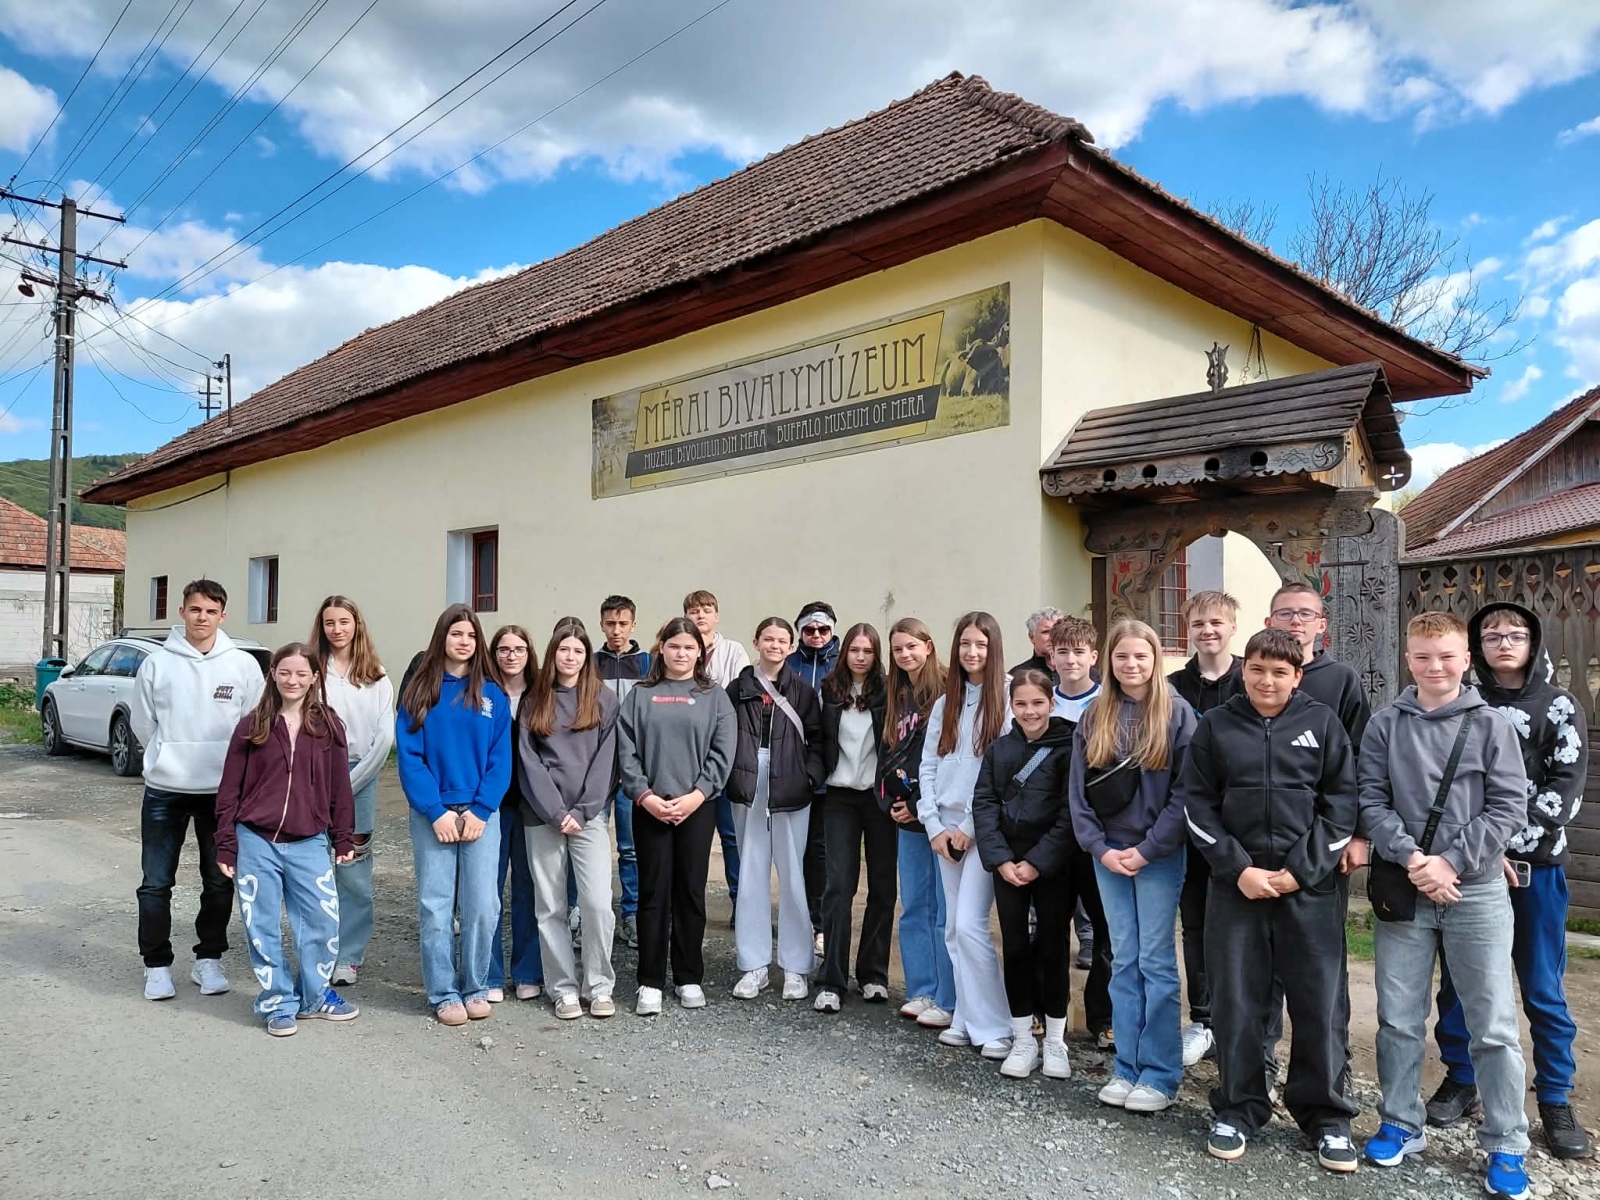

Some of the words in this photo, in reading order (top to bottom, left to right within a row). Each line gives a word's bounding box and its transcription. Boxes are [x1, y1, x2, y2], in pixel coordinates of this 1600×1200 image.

[644, 389, 709, 445] MÉRAI
[718, 333, 926, 429] BIVALYMÚZEUM
[644, 448, 675, 470] MUZEUL
[677, 438, 721, 464] BIVOLULUI
[722, 434, 738, 455] DIN
[740, 428, 767, 451] MERA
[776, 417, 821, 444] BUFFALO
[824, 406, 869, 434] MUSEUM
[873, 402, 887, 423] OF
[891, 394, 926, 420] MERA
